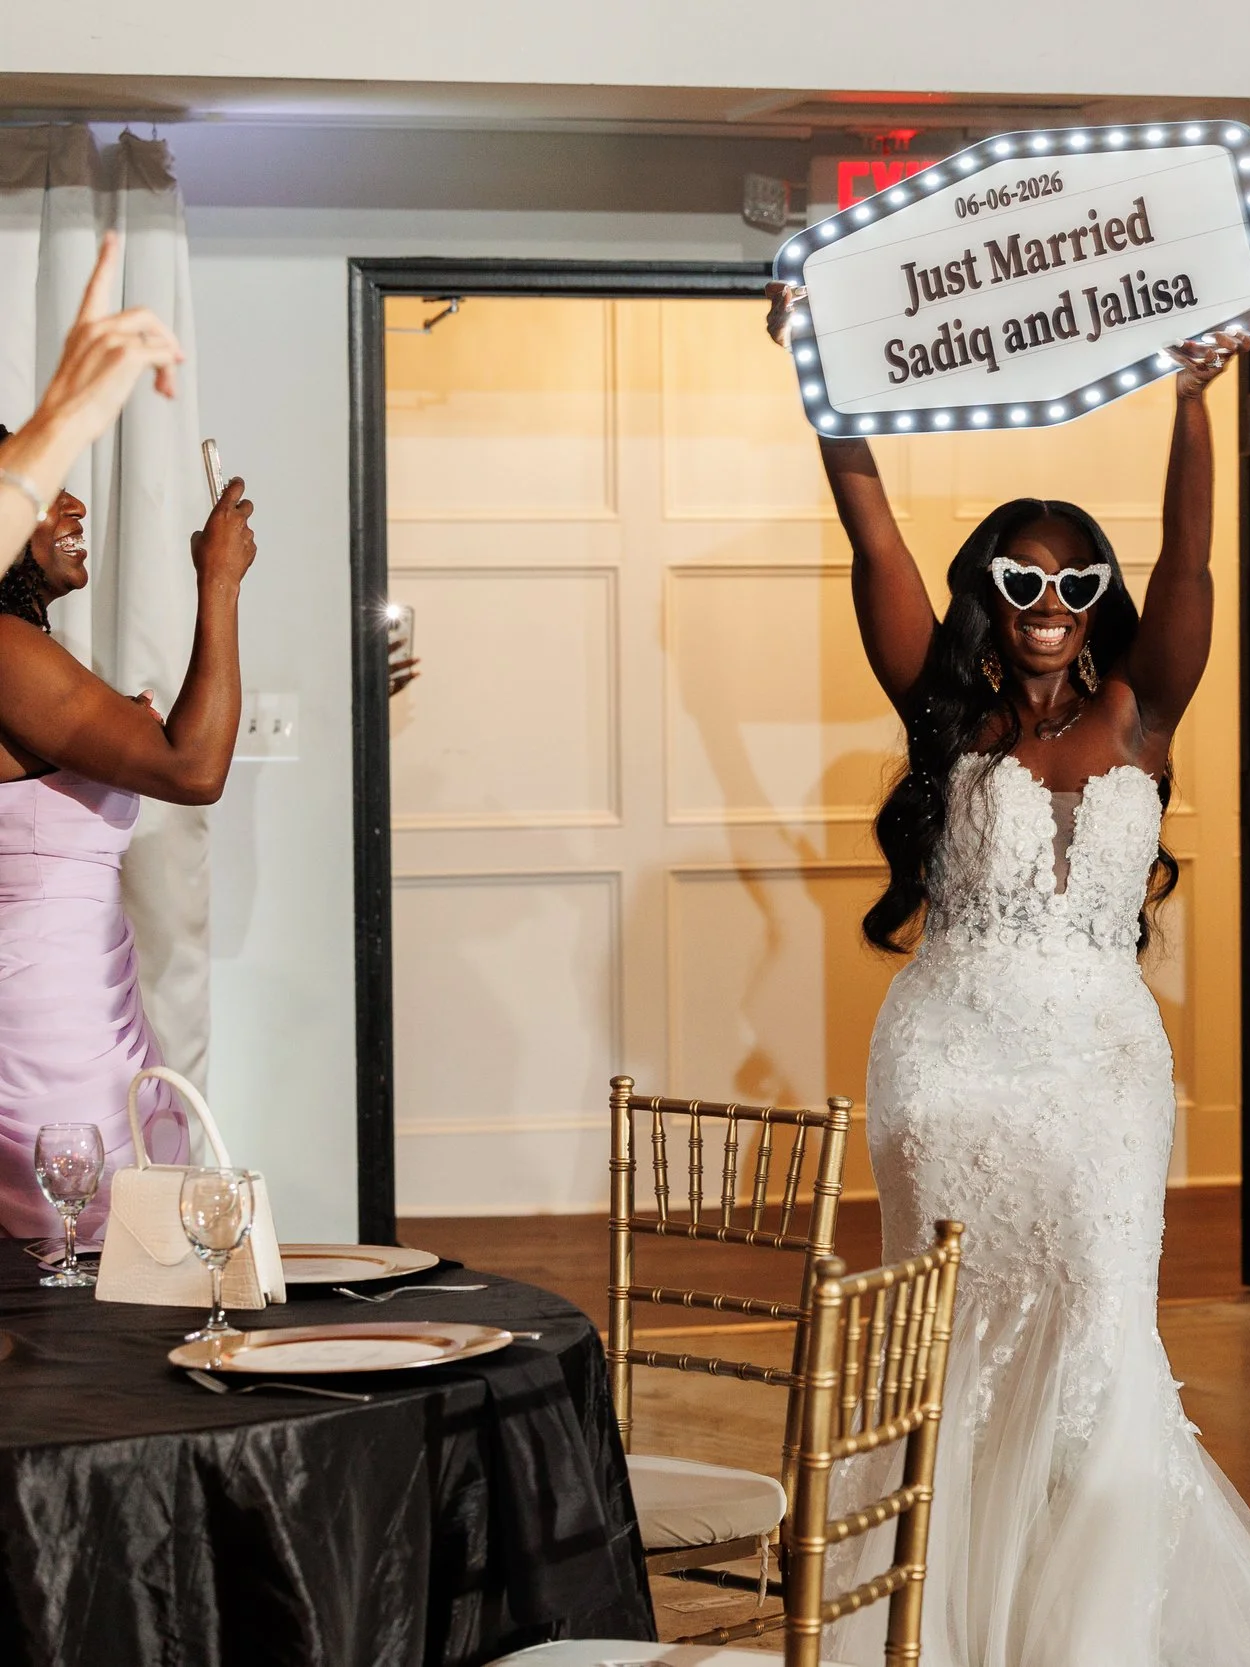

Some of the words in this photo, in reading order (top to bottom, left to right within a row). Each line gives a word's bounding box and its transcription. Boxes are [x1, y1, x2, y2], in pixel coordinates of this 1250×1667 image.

[955, 170, 1064, 219] 06-06-2026
[900, 248, 983, 318] Just
[984, 196, 1155, 285] Married
[884, 318, 1001, 385] Sadiq
[1001, 289, 1081, 354] and
[1081, 269, 1199, 343] Jalisa
